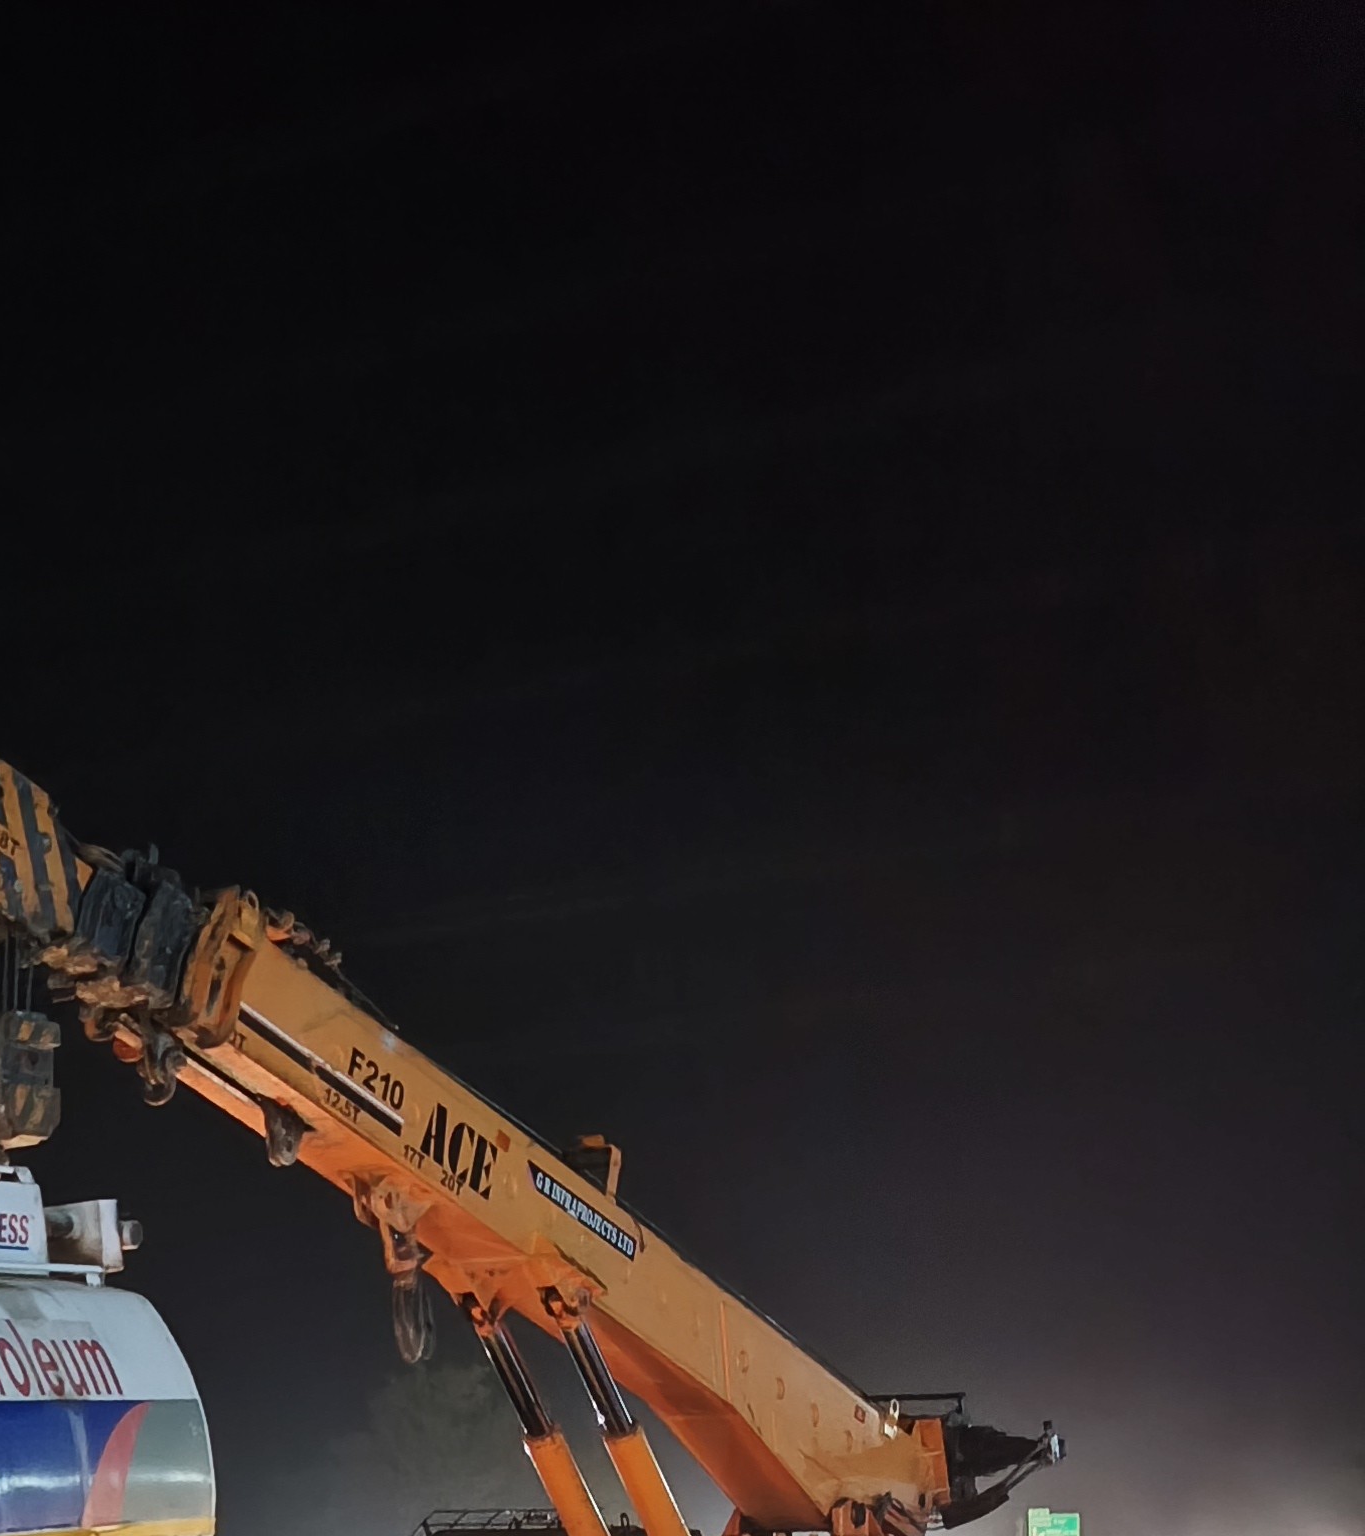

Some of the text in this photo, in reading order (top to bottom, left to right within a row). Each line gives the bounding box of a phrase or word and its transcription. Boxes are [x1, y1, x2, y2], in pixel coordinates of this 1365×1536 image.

[348, 1047, 404, 1110] F210
[324, 1088, 361, 1124] 12.5T
[420, 1103, 498, 1200] ACE
[617, 1232, 634, 1256] LTD
